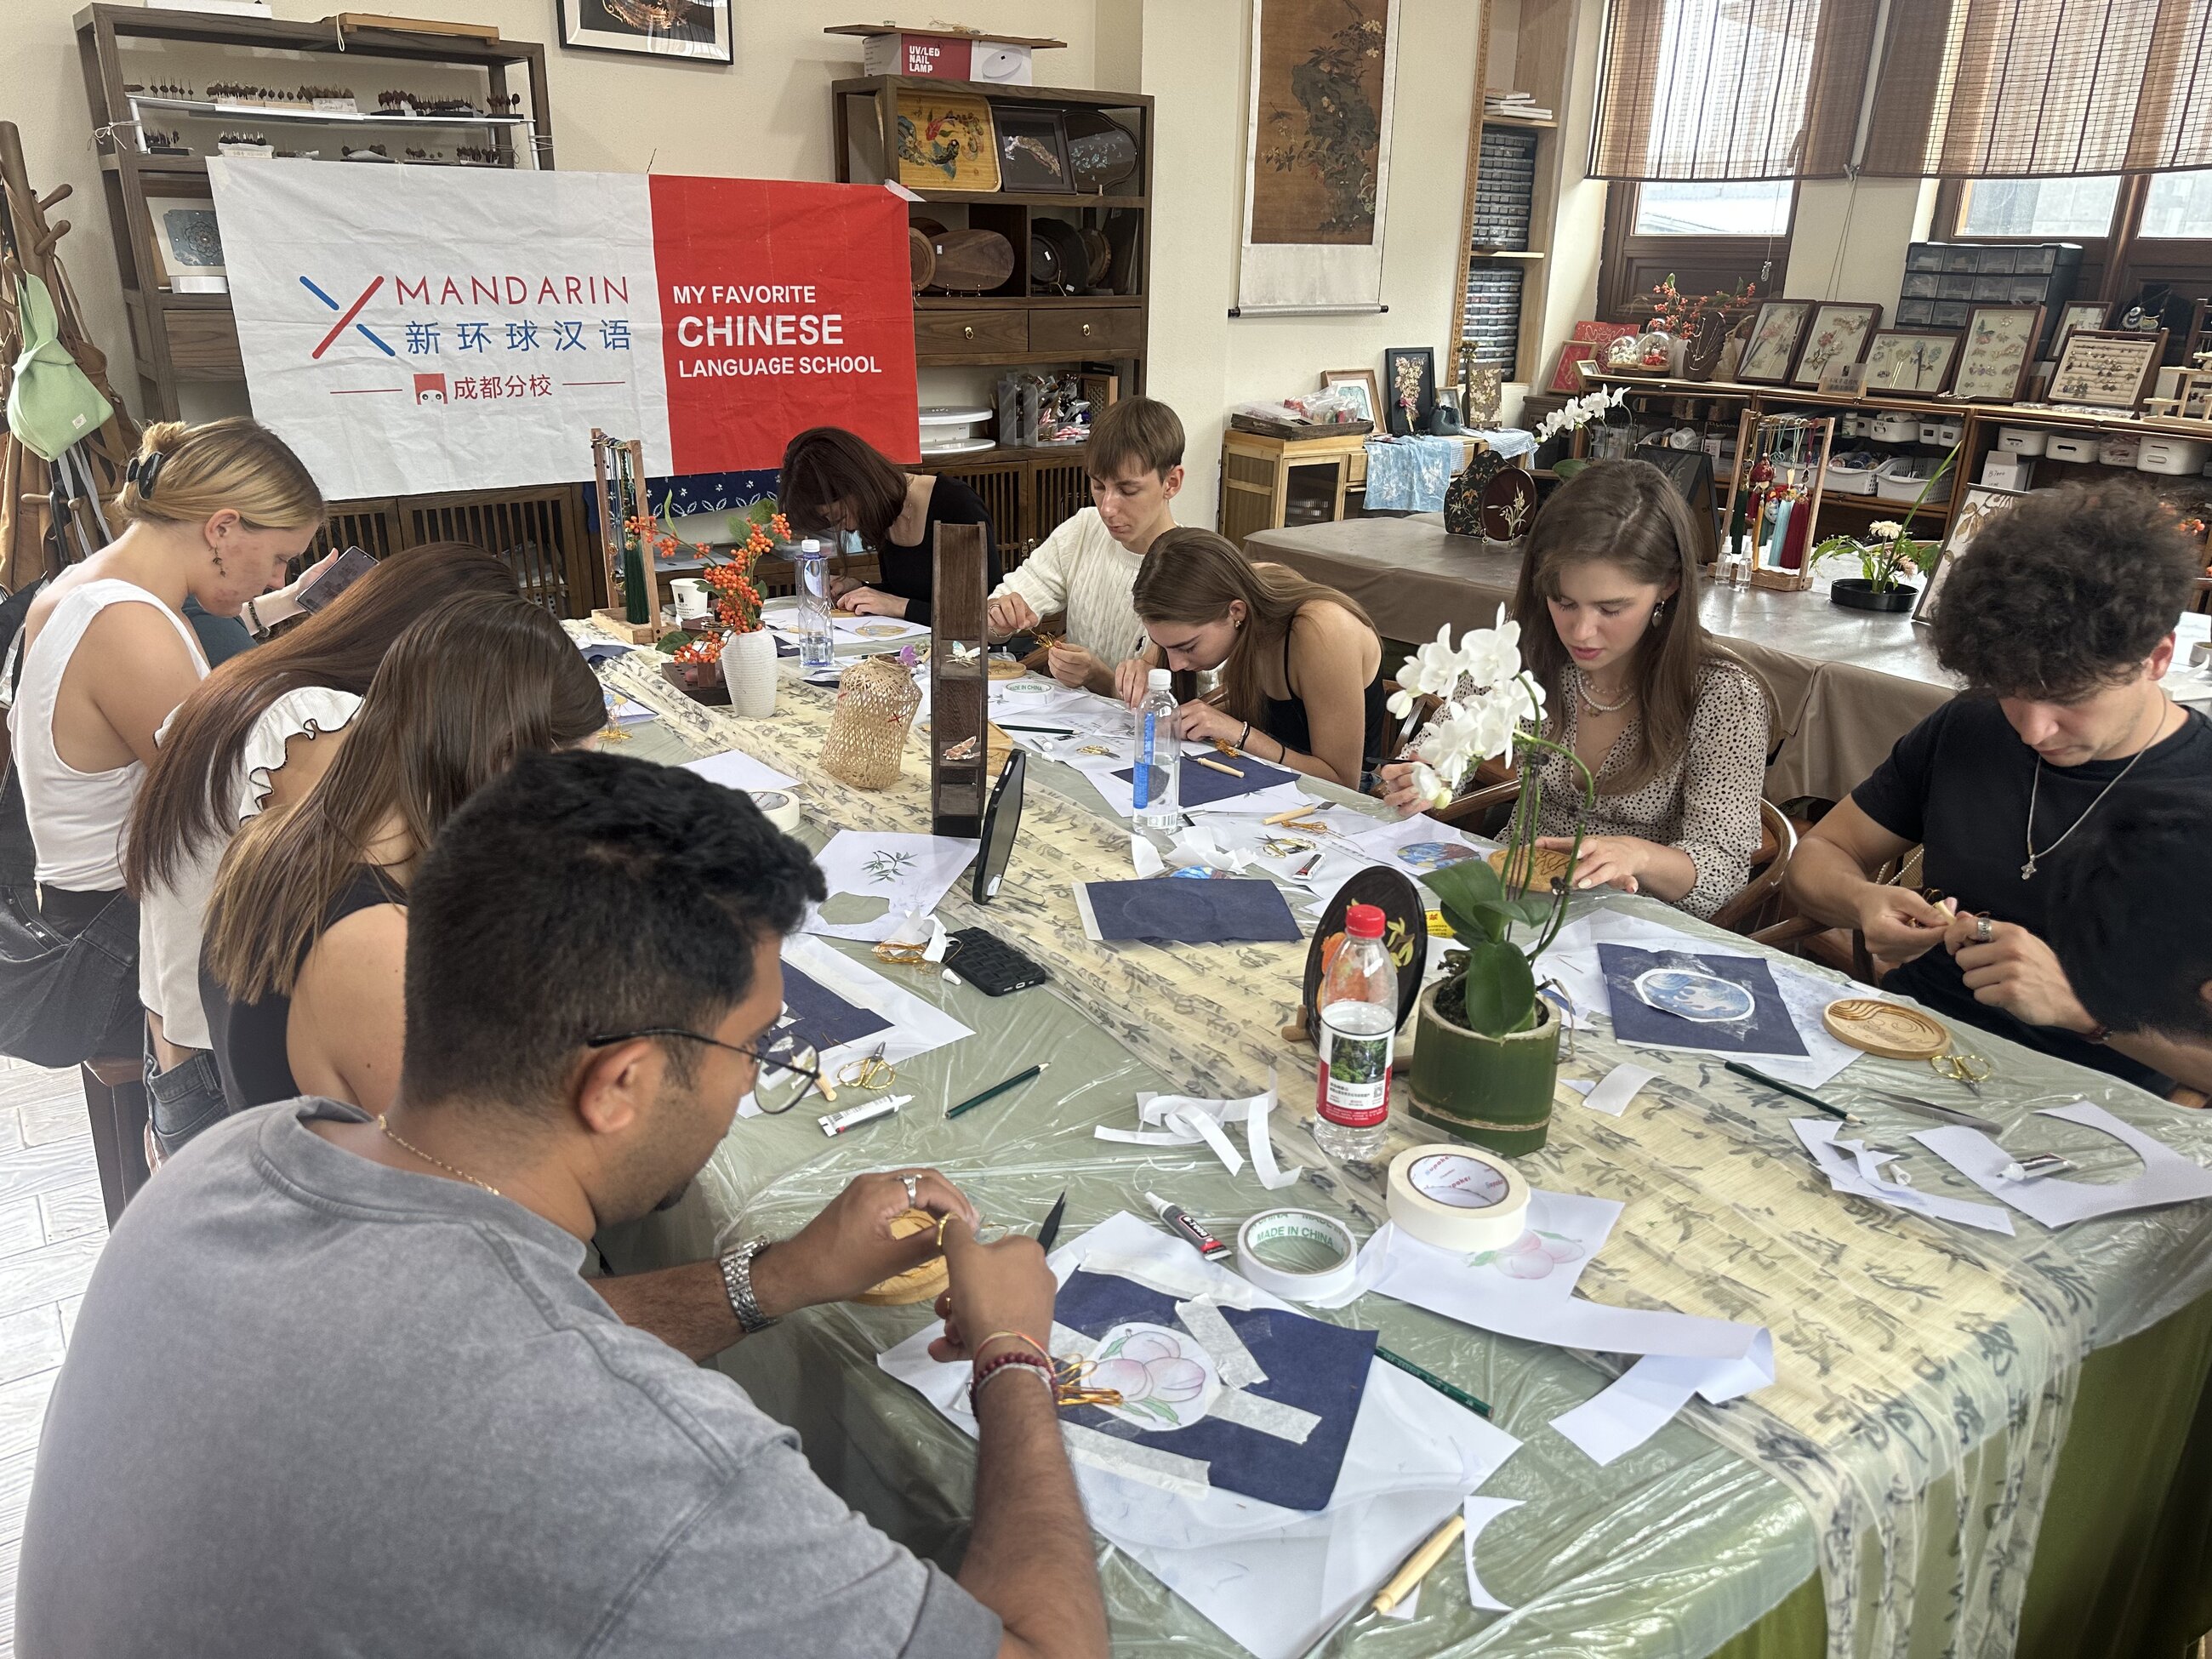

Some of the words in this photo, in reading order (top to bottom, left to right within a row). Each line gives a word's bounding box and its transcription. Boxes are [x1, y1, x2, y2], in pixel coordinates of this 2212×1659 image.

[909, 45, 940, 57] UV/LED
[909, 55, 930, 65] NAIL
[909, 63, 933, 73] LAMP
[395, 275, 630, 305] MANDARIN
[673, 286, 706, 304] MY
[711, 285, 816, 304] FAVORITE
[405, 319, 632, 355] 新环球汉语
[677, 314, 844, 348] CHINESE
[679, 356, 795, 378] LANGUAGE
[799, 356, 882, 374] SCHOOL
[453, 373, 553, 402] 成都分校
[1183, 1216, 1208, 1237] B-7000
[1257, 1226, 1286, 1242] MADE
[1287, 1226, 1299, 1235] IN
[1302, 1227, 1334, 1246] CHINA
